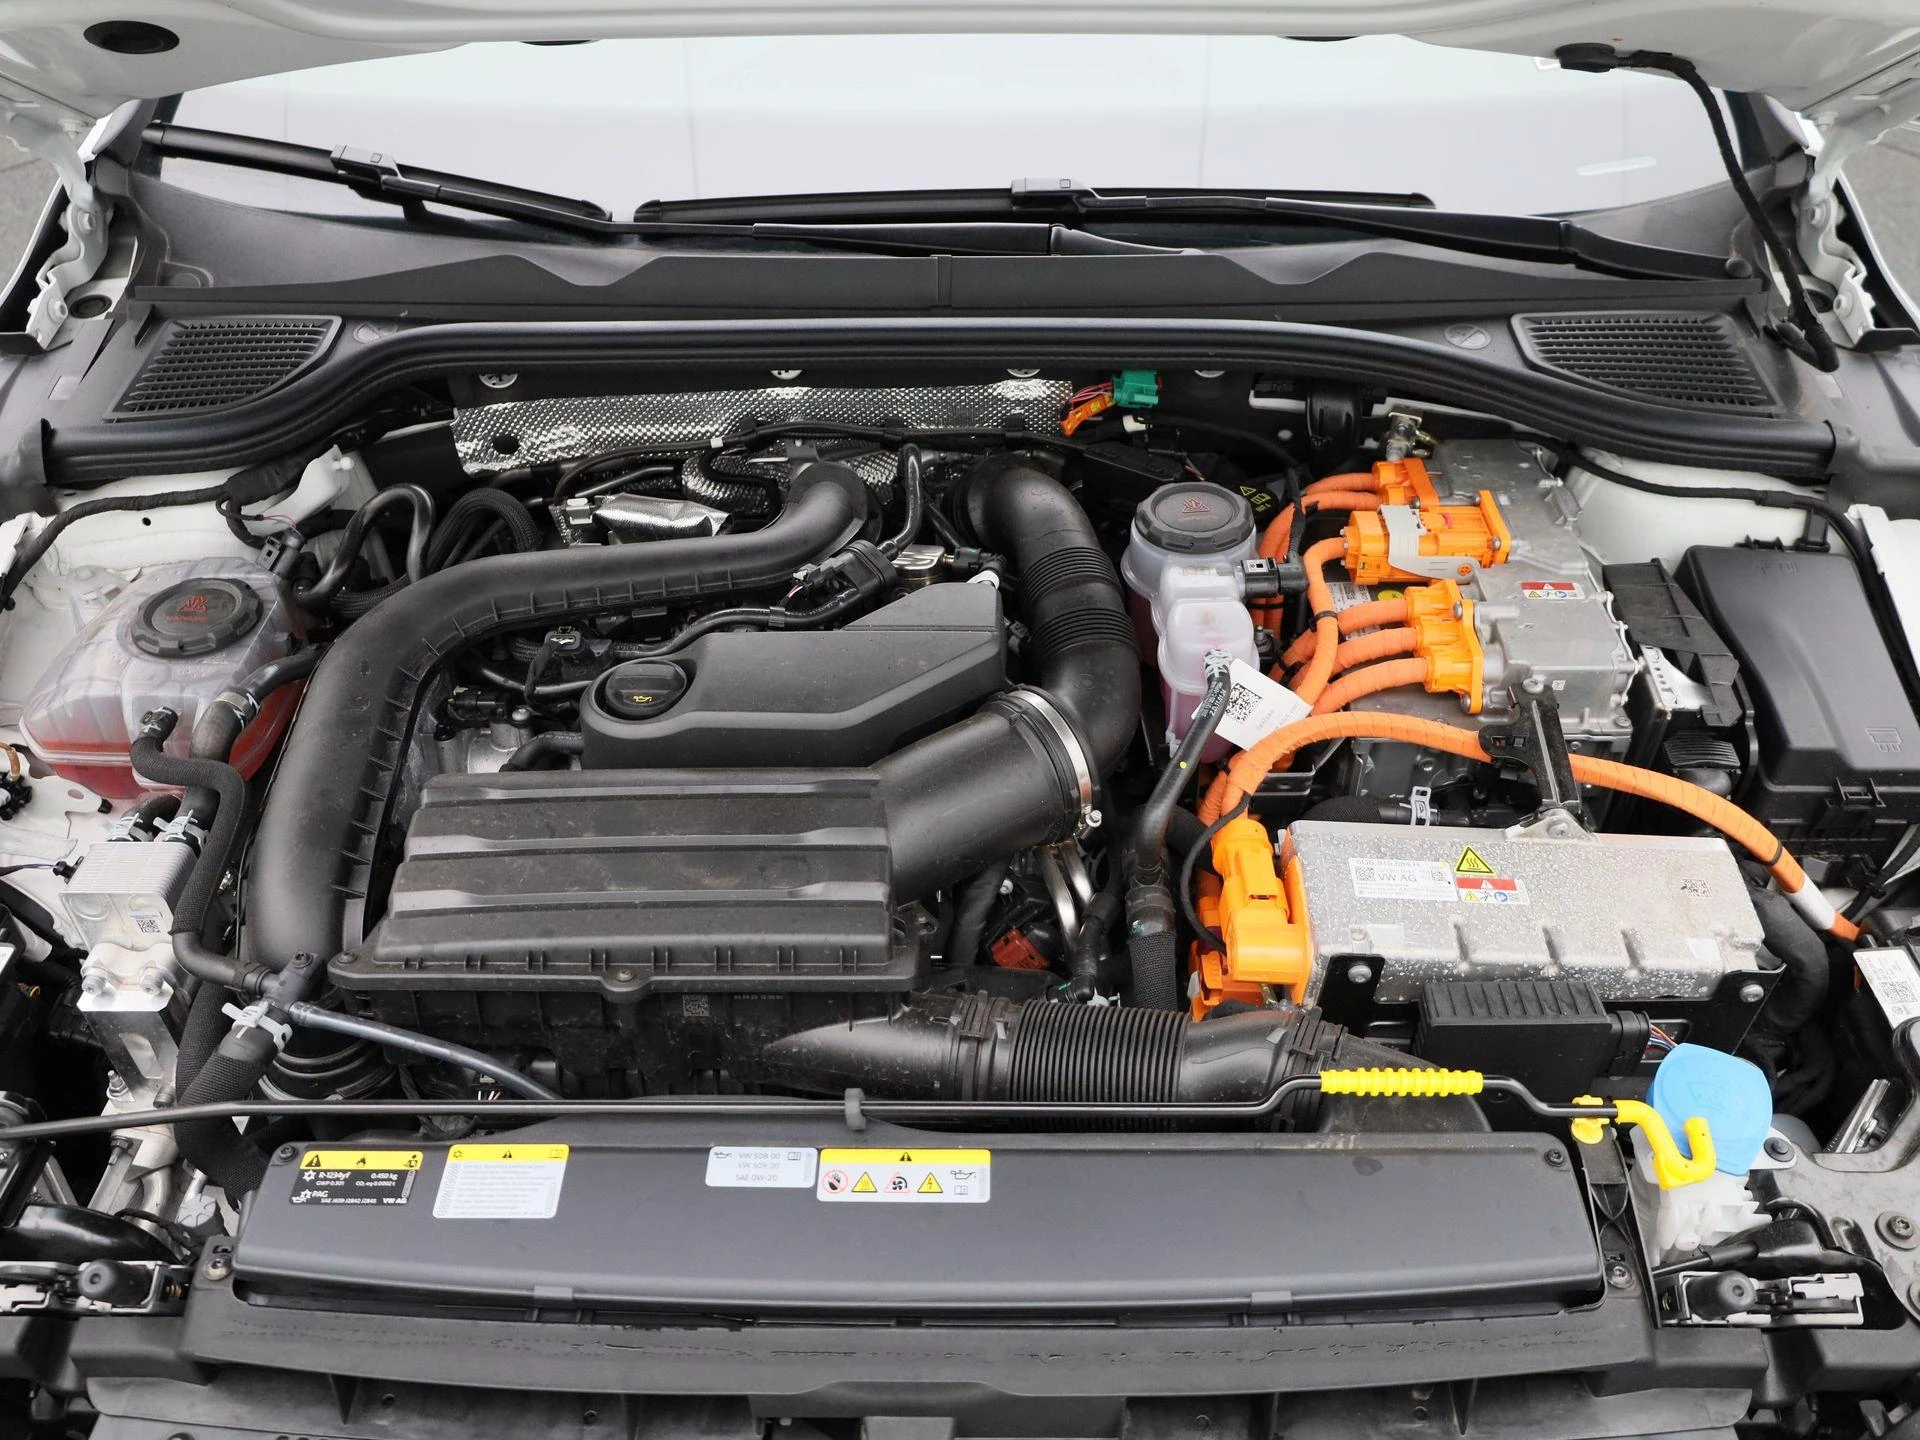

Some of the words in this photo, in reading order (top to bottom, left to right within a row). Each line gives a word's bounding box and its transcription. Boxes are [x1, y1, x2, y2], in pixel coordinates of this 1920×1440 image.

[1377, 872, 1396, 881] VW
[1401, 873, 1417, 882] AG
[319, 1172, 351, 1180] R-1234yf
